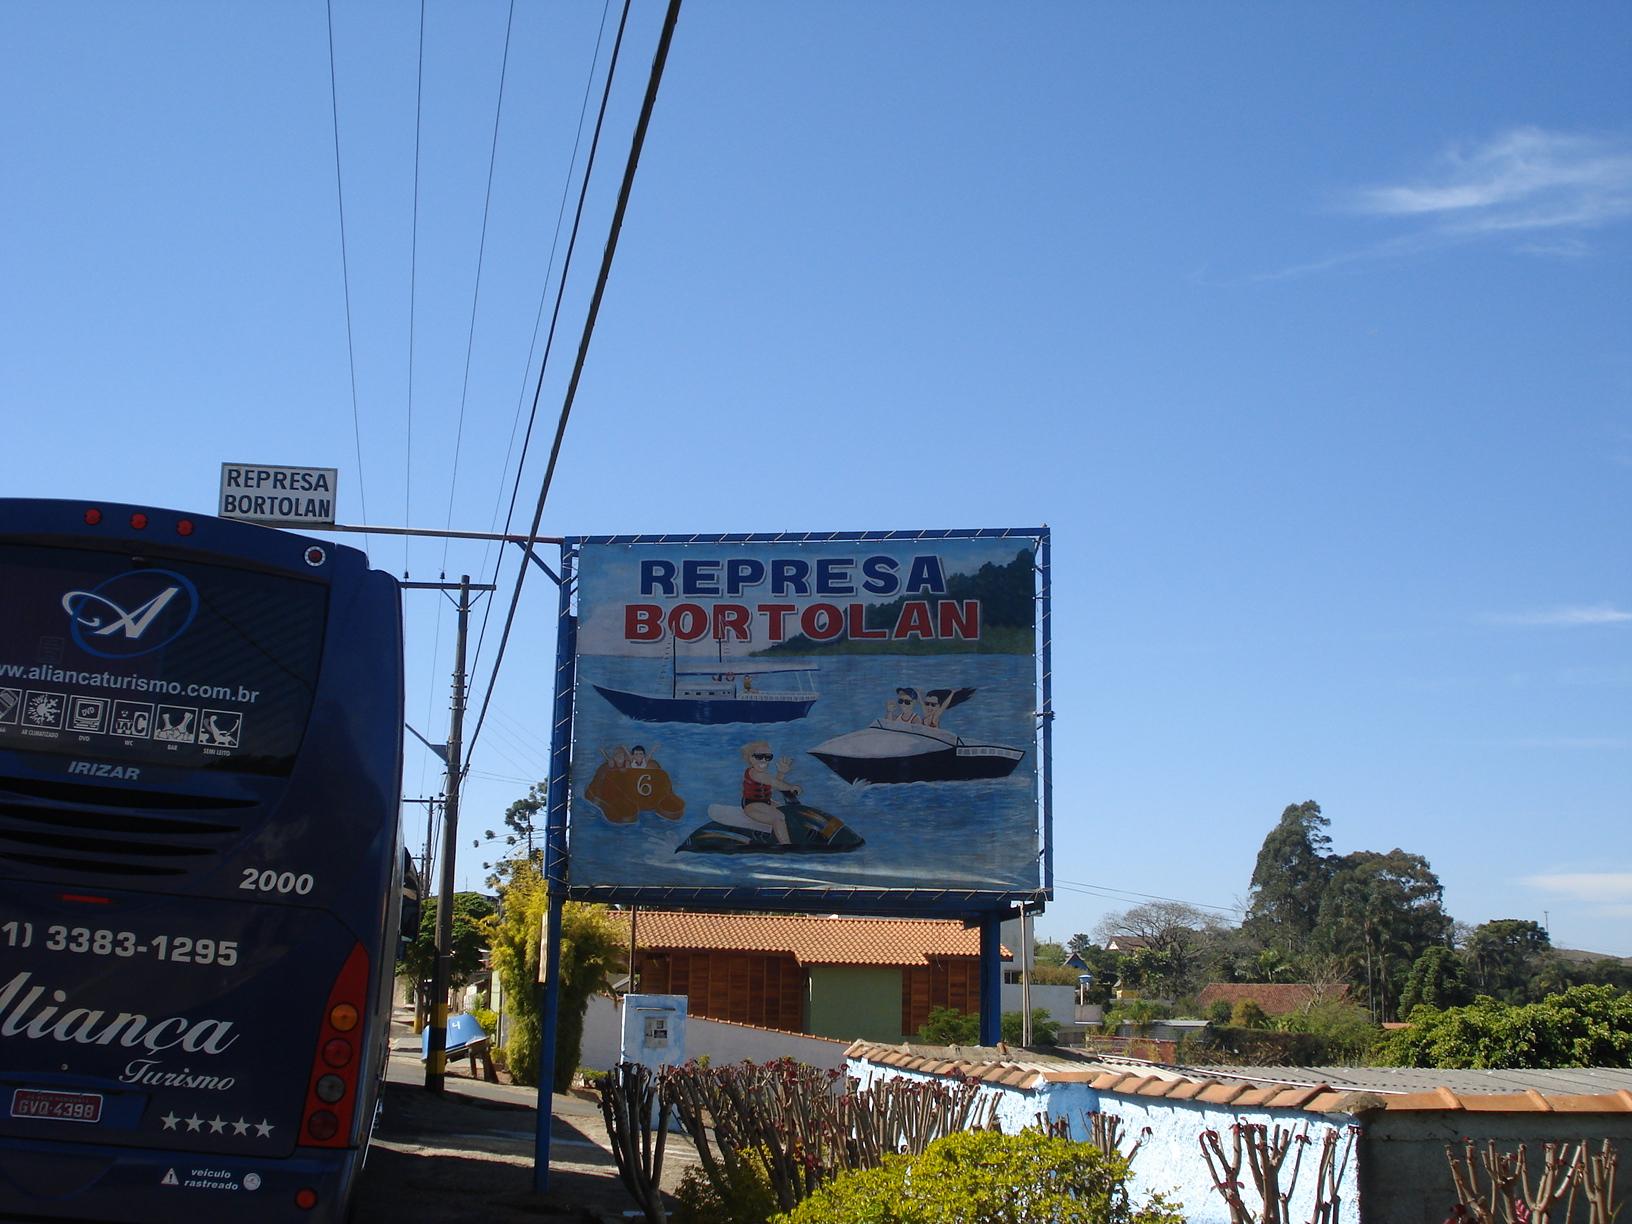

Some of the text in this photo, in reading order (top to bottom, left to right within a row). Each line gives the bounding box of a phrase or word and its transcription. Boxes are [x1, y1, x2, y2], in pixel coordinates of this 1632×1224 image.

[227, 469, 329, 492] REPRESA
[224, 495, 330, 517] BORTOLAN
[639, 554, 949, 597] REPRESA
[623, 600, 981, 643] BORTOLAN
[67, 761, 141, 781] IRIZAR
[635, 774, 653, 797] 6
[239, 868, 314, 895] 2000
[46, 925, 239, 967] 3383-1295
[118, 1059, 235, 1092] Turismo
[184, 1179, 239, 1191] rastreado
